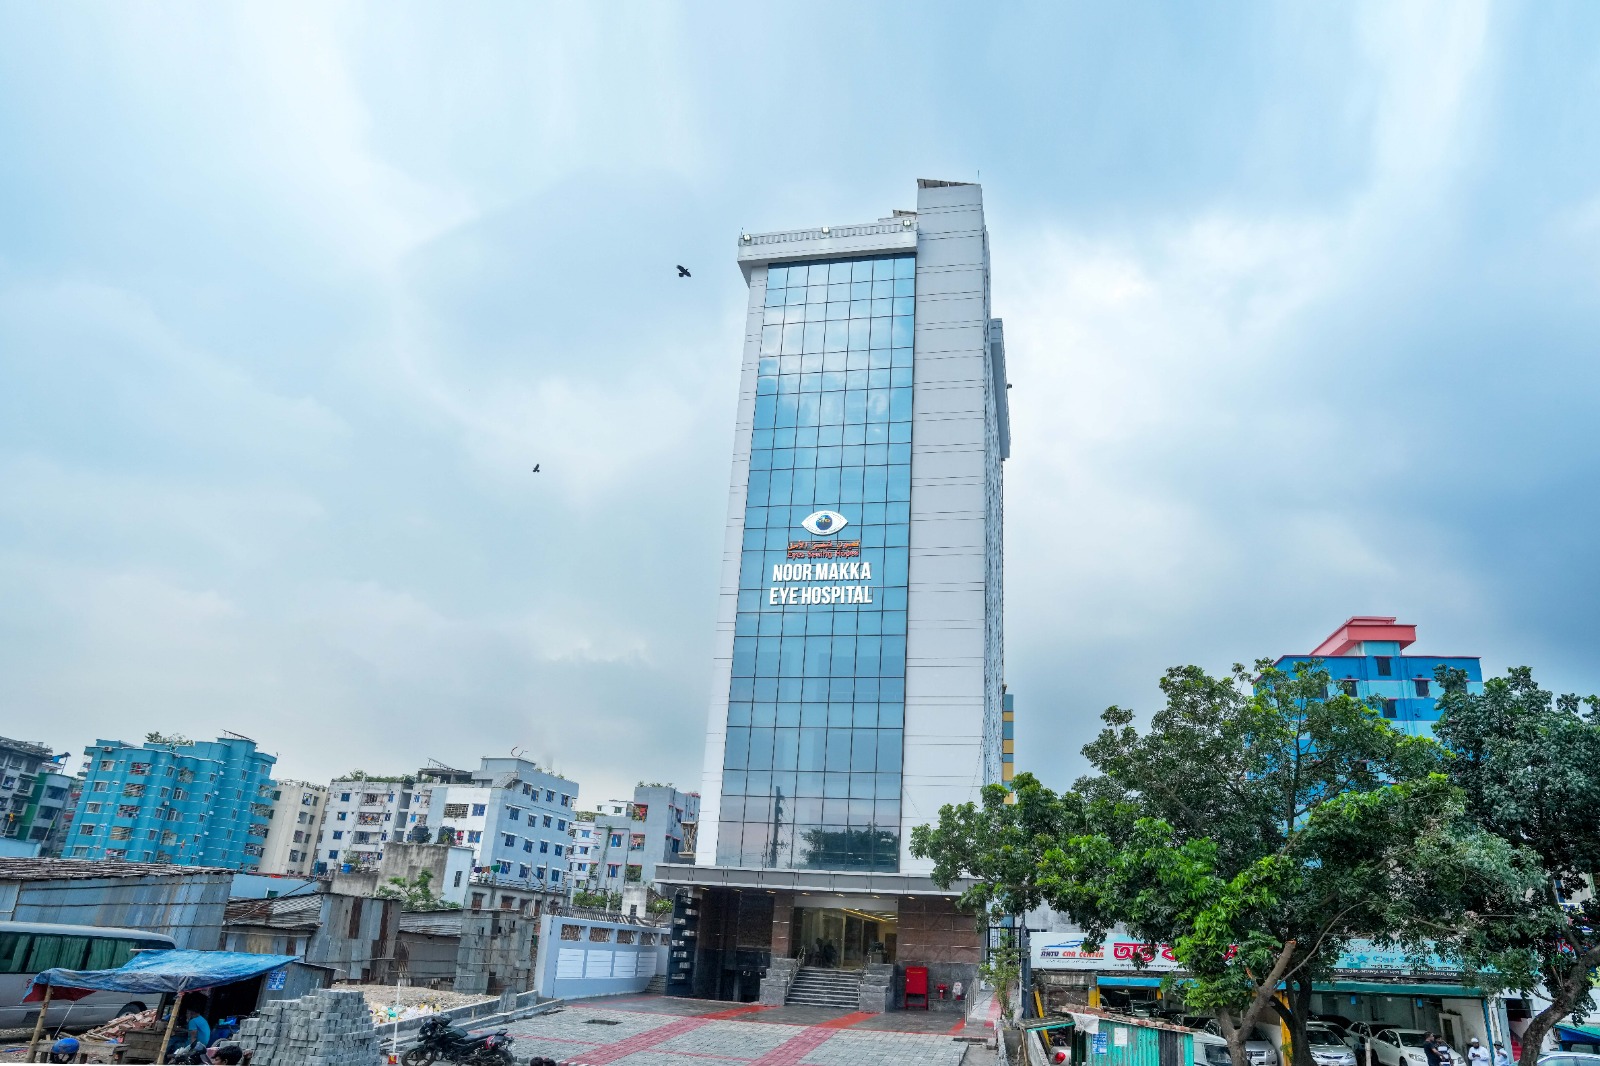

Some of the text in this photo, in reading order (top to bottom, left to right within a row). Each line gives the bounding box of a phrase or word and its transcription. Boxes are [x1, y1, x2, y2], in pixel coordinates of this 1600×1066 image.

[787, 551, 805, 560] Eyes
[772, 562, 871, 581] NOOR MAKKA
[769, 585, 873, 605] EYE HOSPITAL
